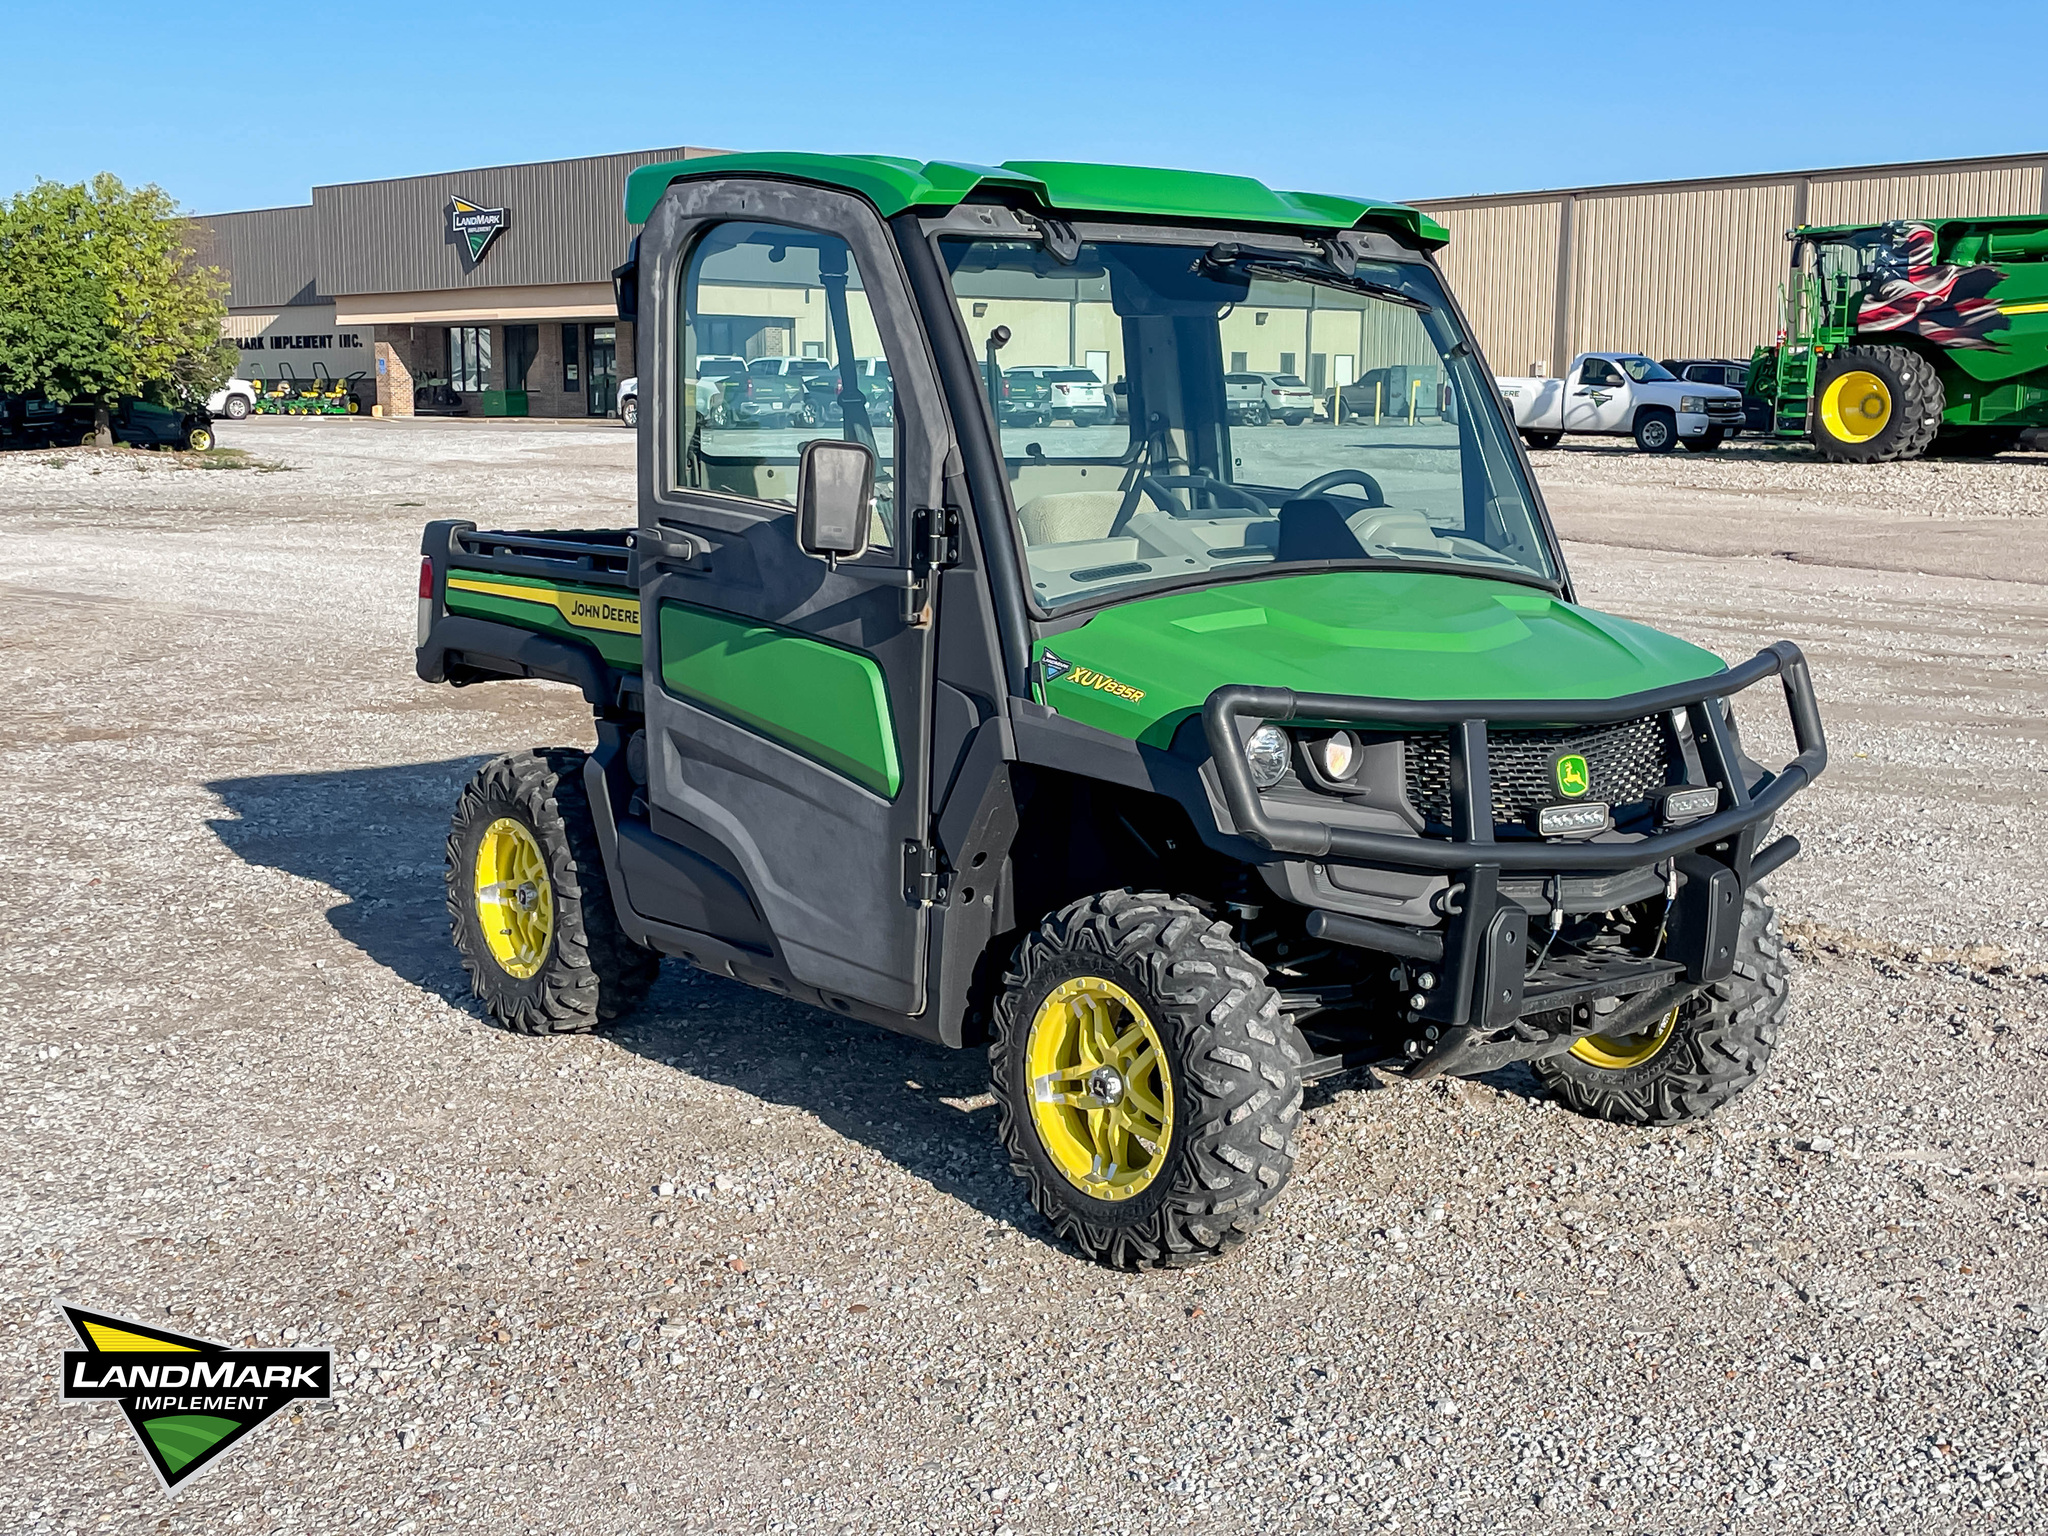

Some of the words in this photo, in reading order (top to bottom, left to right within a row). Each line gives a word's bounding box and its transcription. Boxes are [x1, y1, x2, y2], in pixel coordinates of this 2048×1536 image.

[456, 214, 500, 226] LANDMARK
[270, 335, 333, 350] IMPLEMENT
[339, 334, 363, 348] INC.
[571, 600, 600, 619] JOHN
[602, 604, 639, 624] DEERE
[1066, 665, 1146, 703] XUV835R
